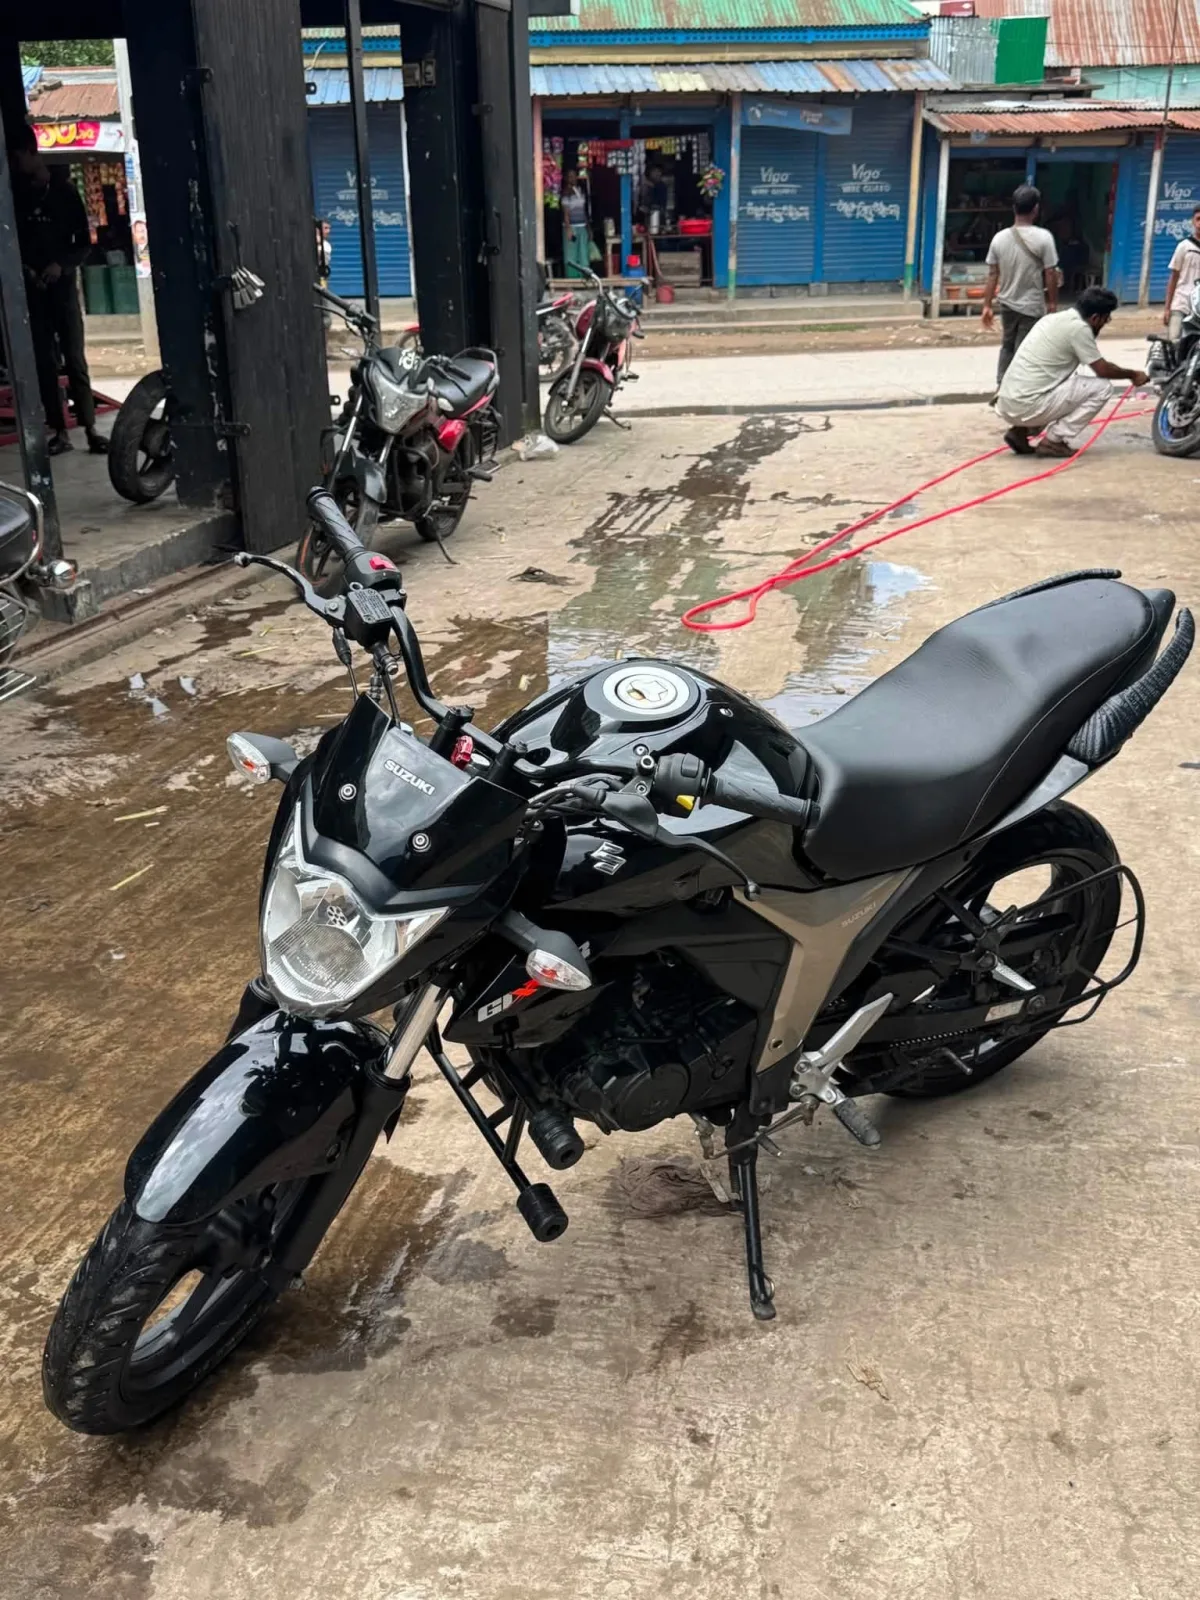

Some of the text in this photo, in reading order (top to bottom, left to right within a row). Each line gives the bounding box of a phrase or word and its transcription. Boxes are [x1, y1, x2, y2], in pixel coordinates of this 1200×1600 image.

[760, 166, 791, 185] Vigo
[852, 163, 885, 182] Vigo
[1164, 181, 1193, 200] Vigo
[384, 760, 435, 795] SUZUKI
